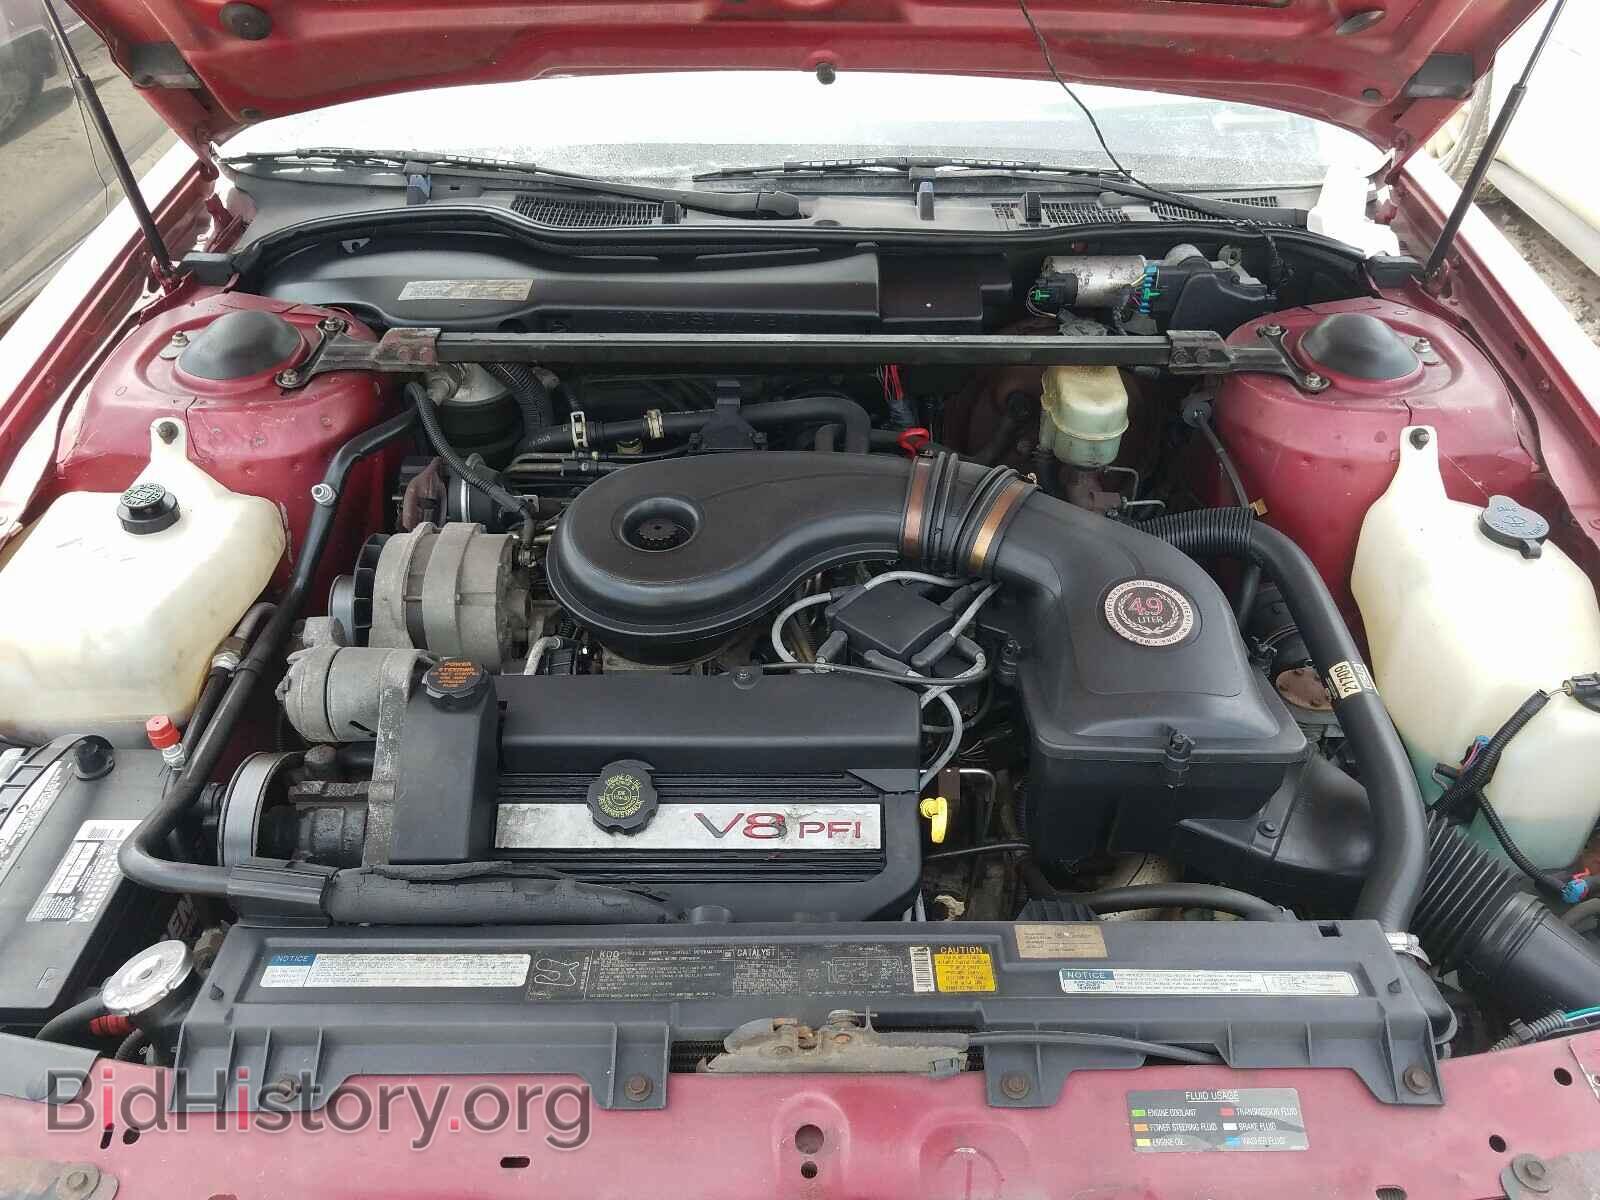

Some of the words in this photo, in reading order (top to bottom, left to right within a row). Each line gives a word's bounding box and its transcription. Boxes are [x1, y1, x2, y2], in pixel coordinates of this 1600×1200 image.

[694, 812, 788, 839] V8
[798, 821, 861, 839] PFI
[736, 949, 777, 957] CATALYST
[940, 946, 983, 954] CAUTION
[1066, 970, 1106, 980] NOTICE
[1185, 1091, 1209, 1101] FLUID
[1211, 1090, 1240, 1100] USAGE
